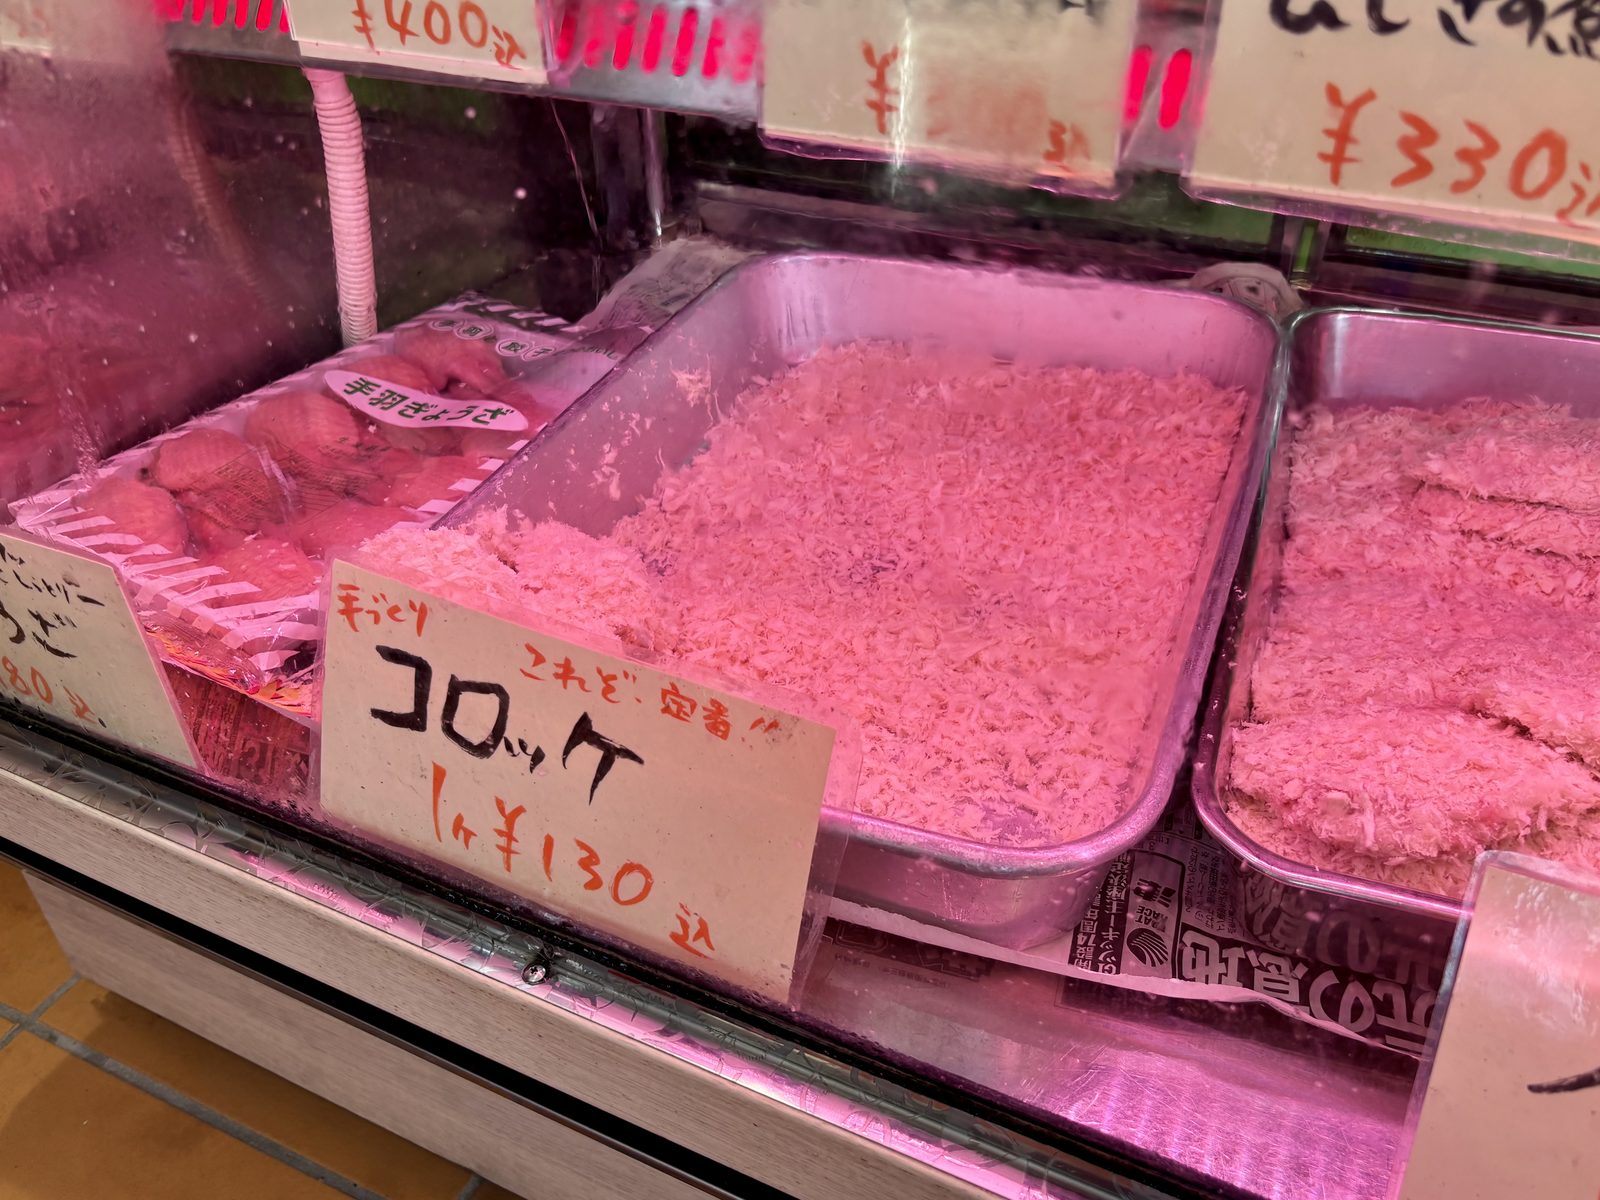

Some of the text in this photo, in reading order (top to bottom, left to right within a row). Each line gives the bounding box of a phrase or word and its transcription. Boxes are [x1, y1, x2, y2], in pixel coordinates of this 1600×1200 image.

[343, 376, 516, 426] 手羽ぎょうざ
[336, 582, 429, 636] 手づくり
[370, 644, 645, 805] コロッケ
